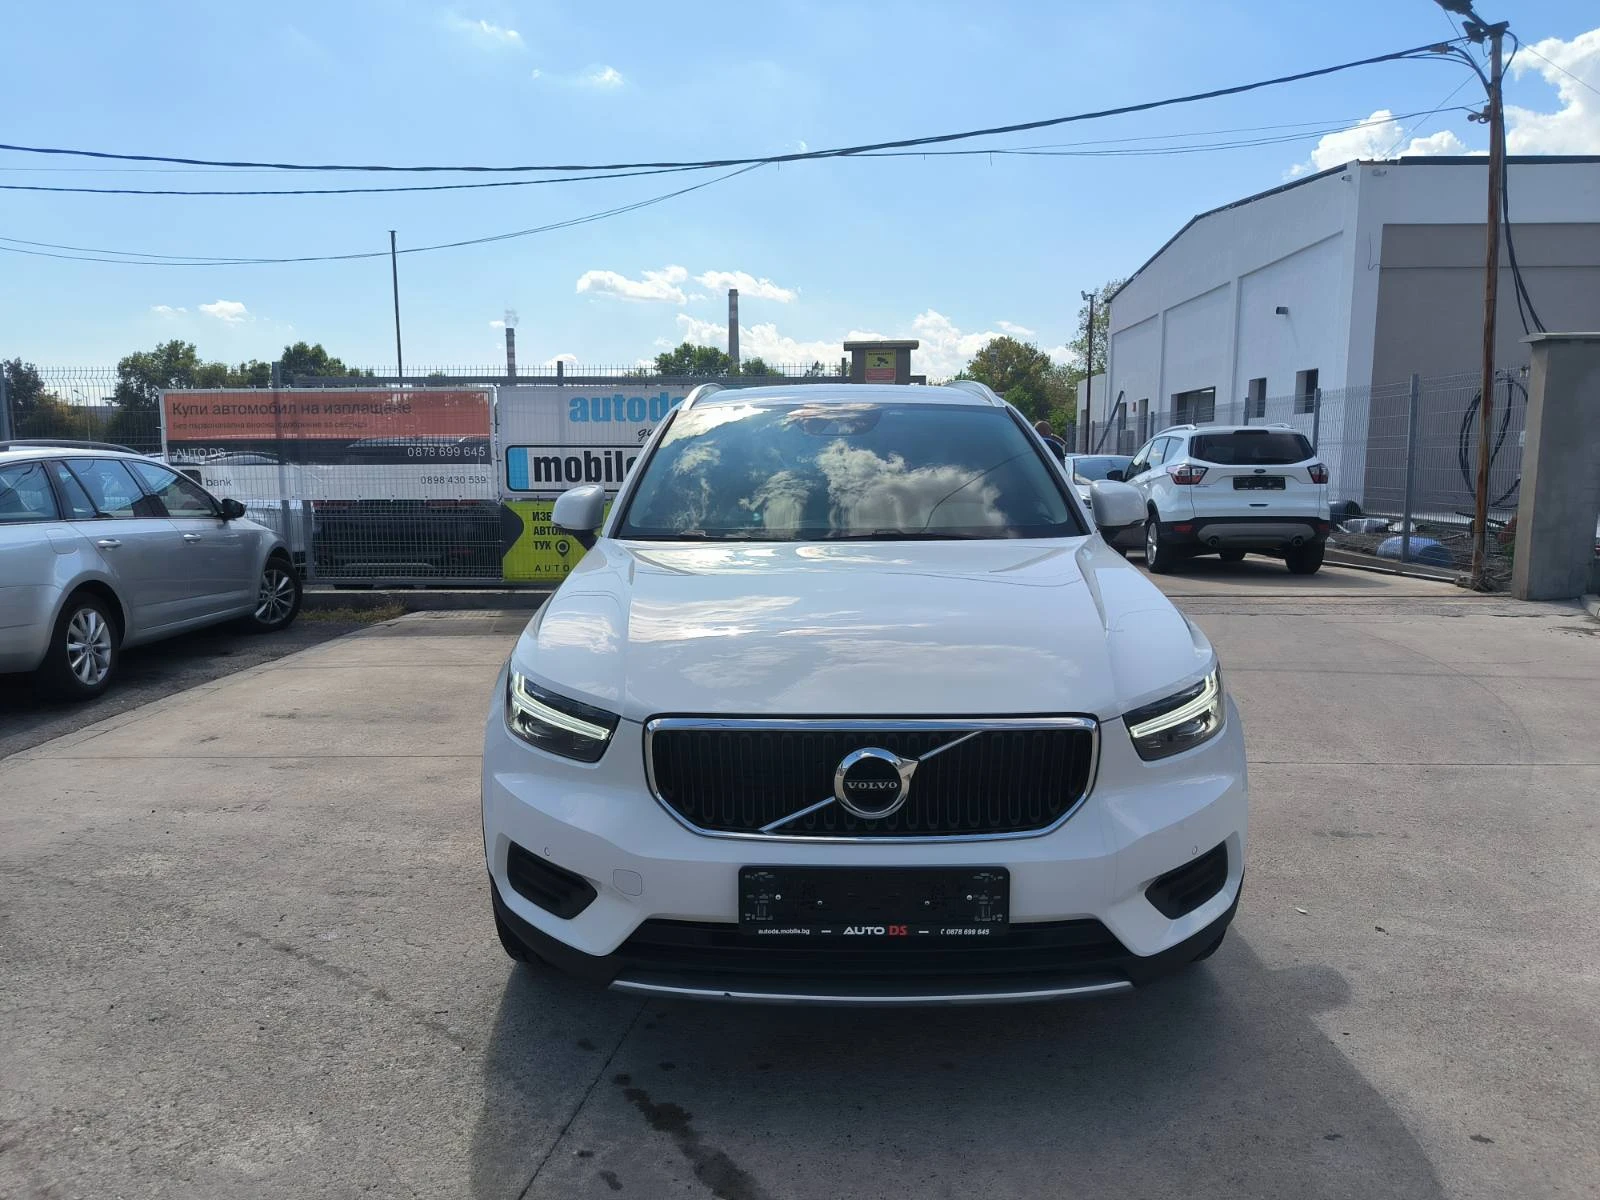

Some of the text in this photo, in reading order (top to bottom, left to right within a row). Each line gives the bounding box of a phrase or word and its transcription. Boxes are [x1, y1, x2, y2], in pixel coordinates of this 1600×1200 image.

[172, 402, 412, 417] Купи автомобил на изплащане
[176, 447, 226, 458] AUTO DS
[407, 447, 486, 457] 0878 699 645
[421, 475, 487, 485] 0898 430 539
[532, 511, 552, 521] ИЗБ
[534, 525, 567, 536] АВТО
[533, 540, 552, 550] ТУК
[535, 564, 570, 572] AUTO
[845, 781, 898, 789] VOLVO
[843, 926, 885, 935] AUTO
[888, 925, 908, 936] DS
